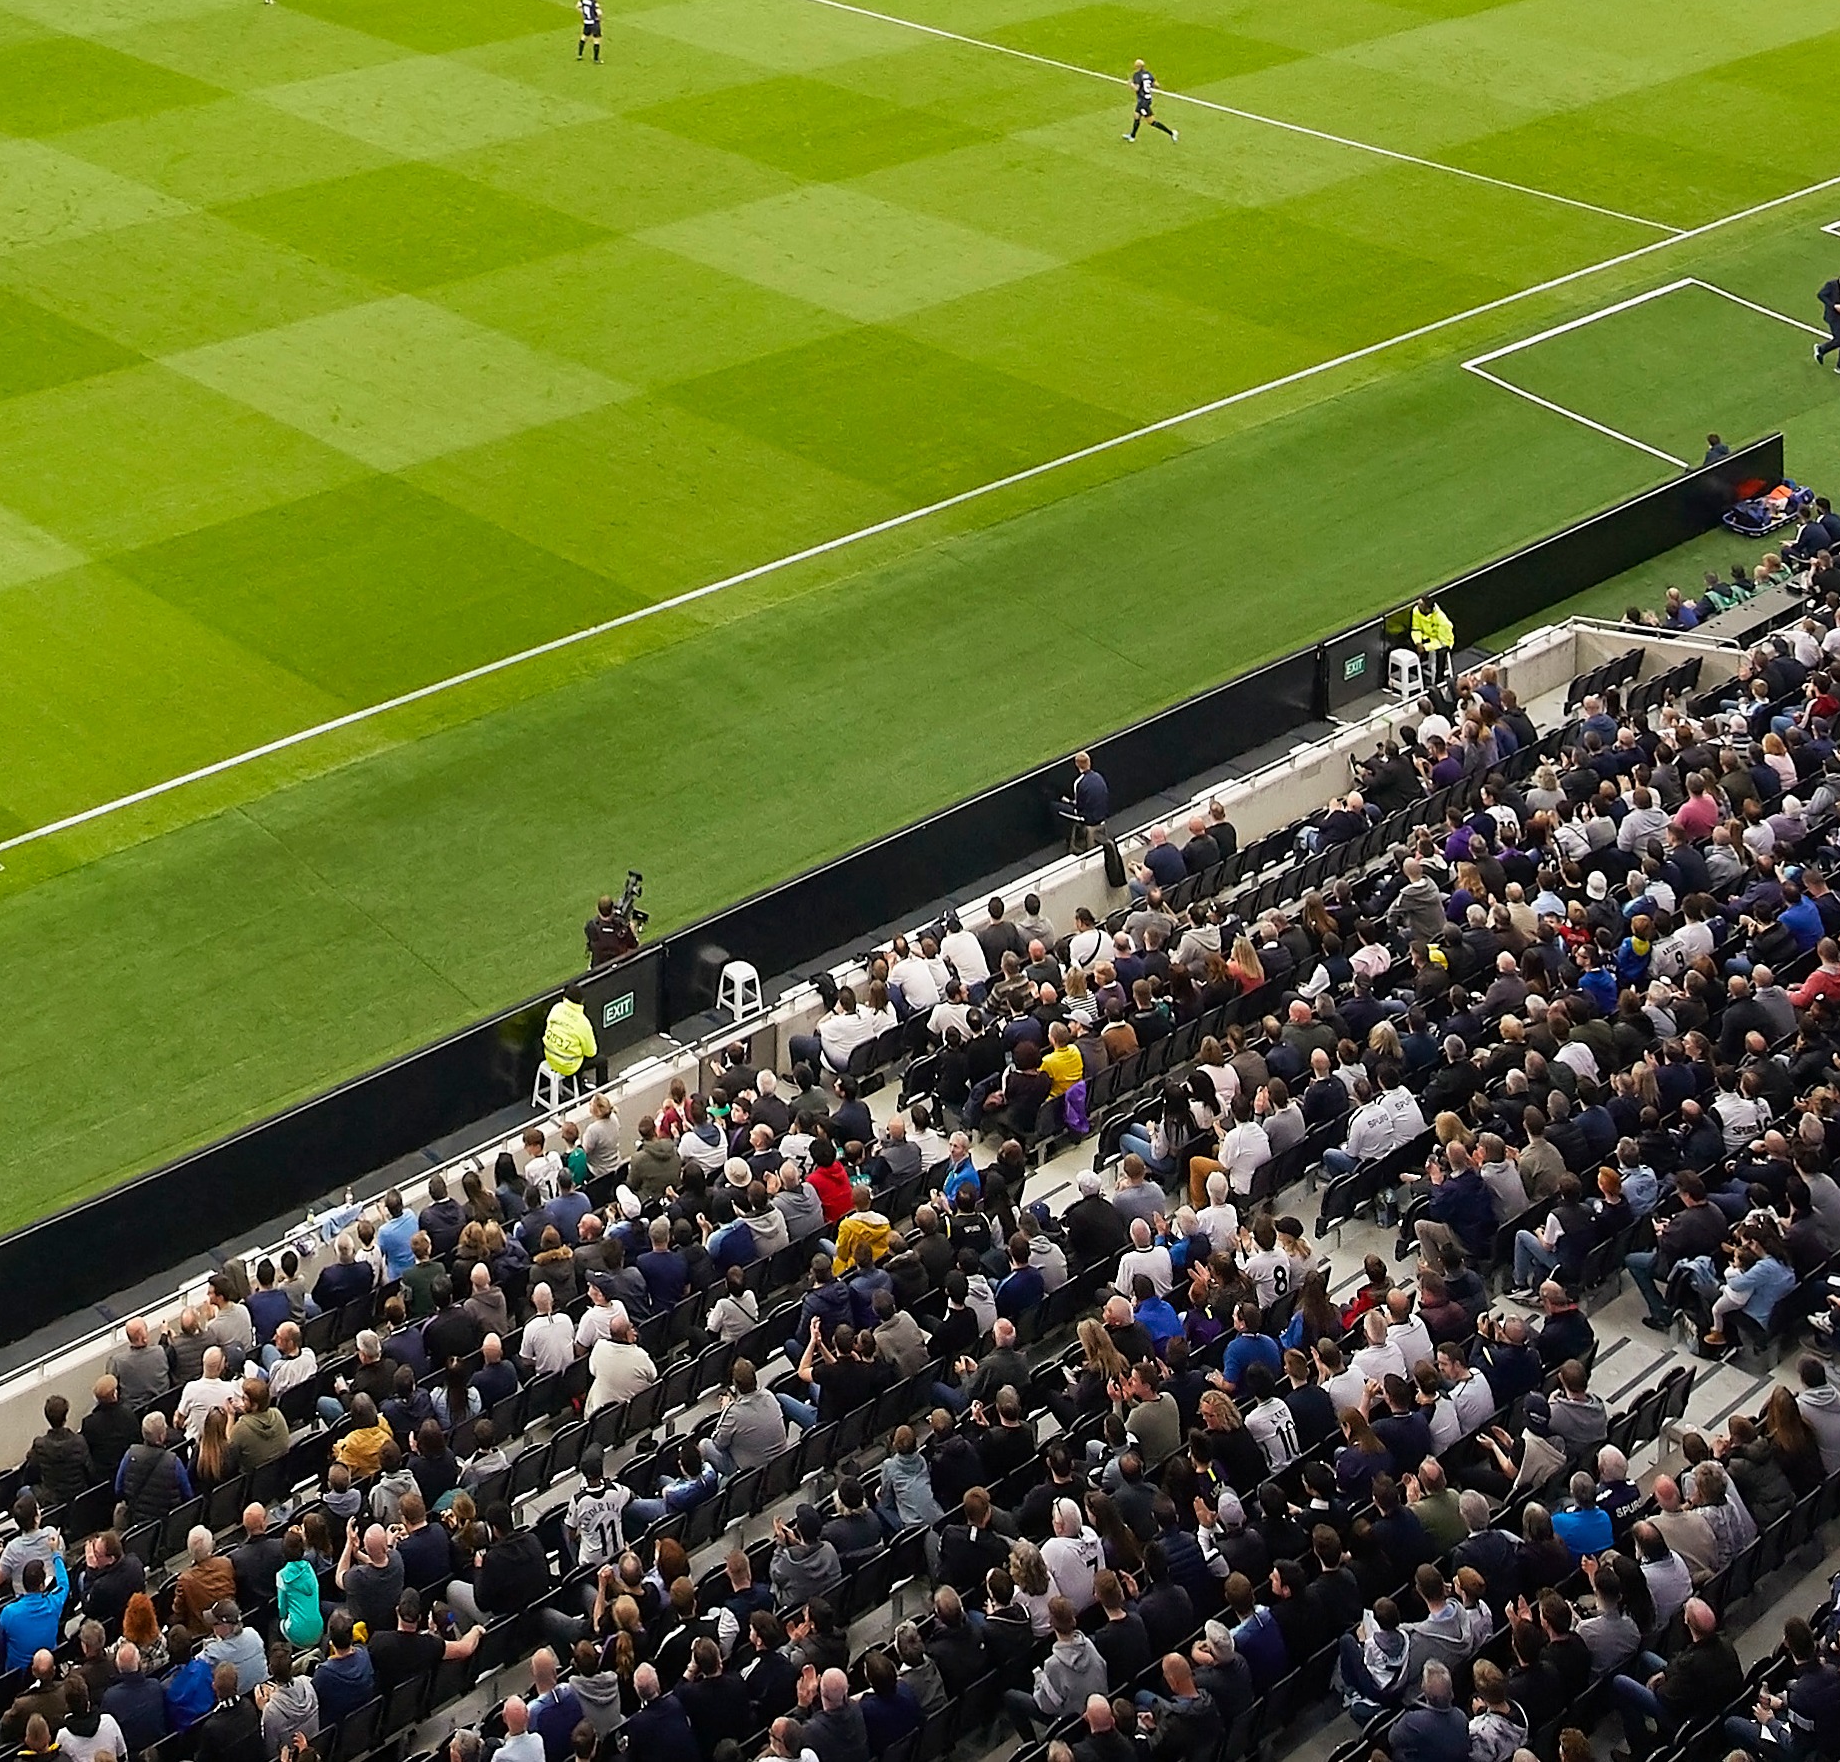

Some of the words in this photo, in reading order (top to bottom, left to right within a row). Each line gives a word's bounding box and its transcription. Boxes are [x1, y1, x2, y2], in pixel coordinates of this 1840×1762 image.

[1346, 658, 1365, 676] EXIT
[1675, 950, 1685, 969] 9
[606, 999, 631, 1021] EXIT
[1273, 1265, 1289, 1295] 8
[1275, 1419, 1301, 1460] 10
[595, 1520, 618, 1557] 11
